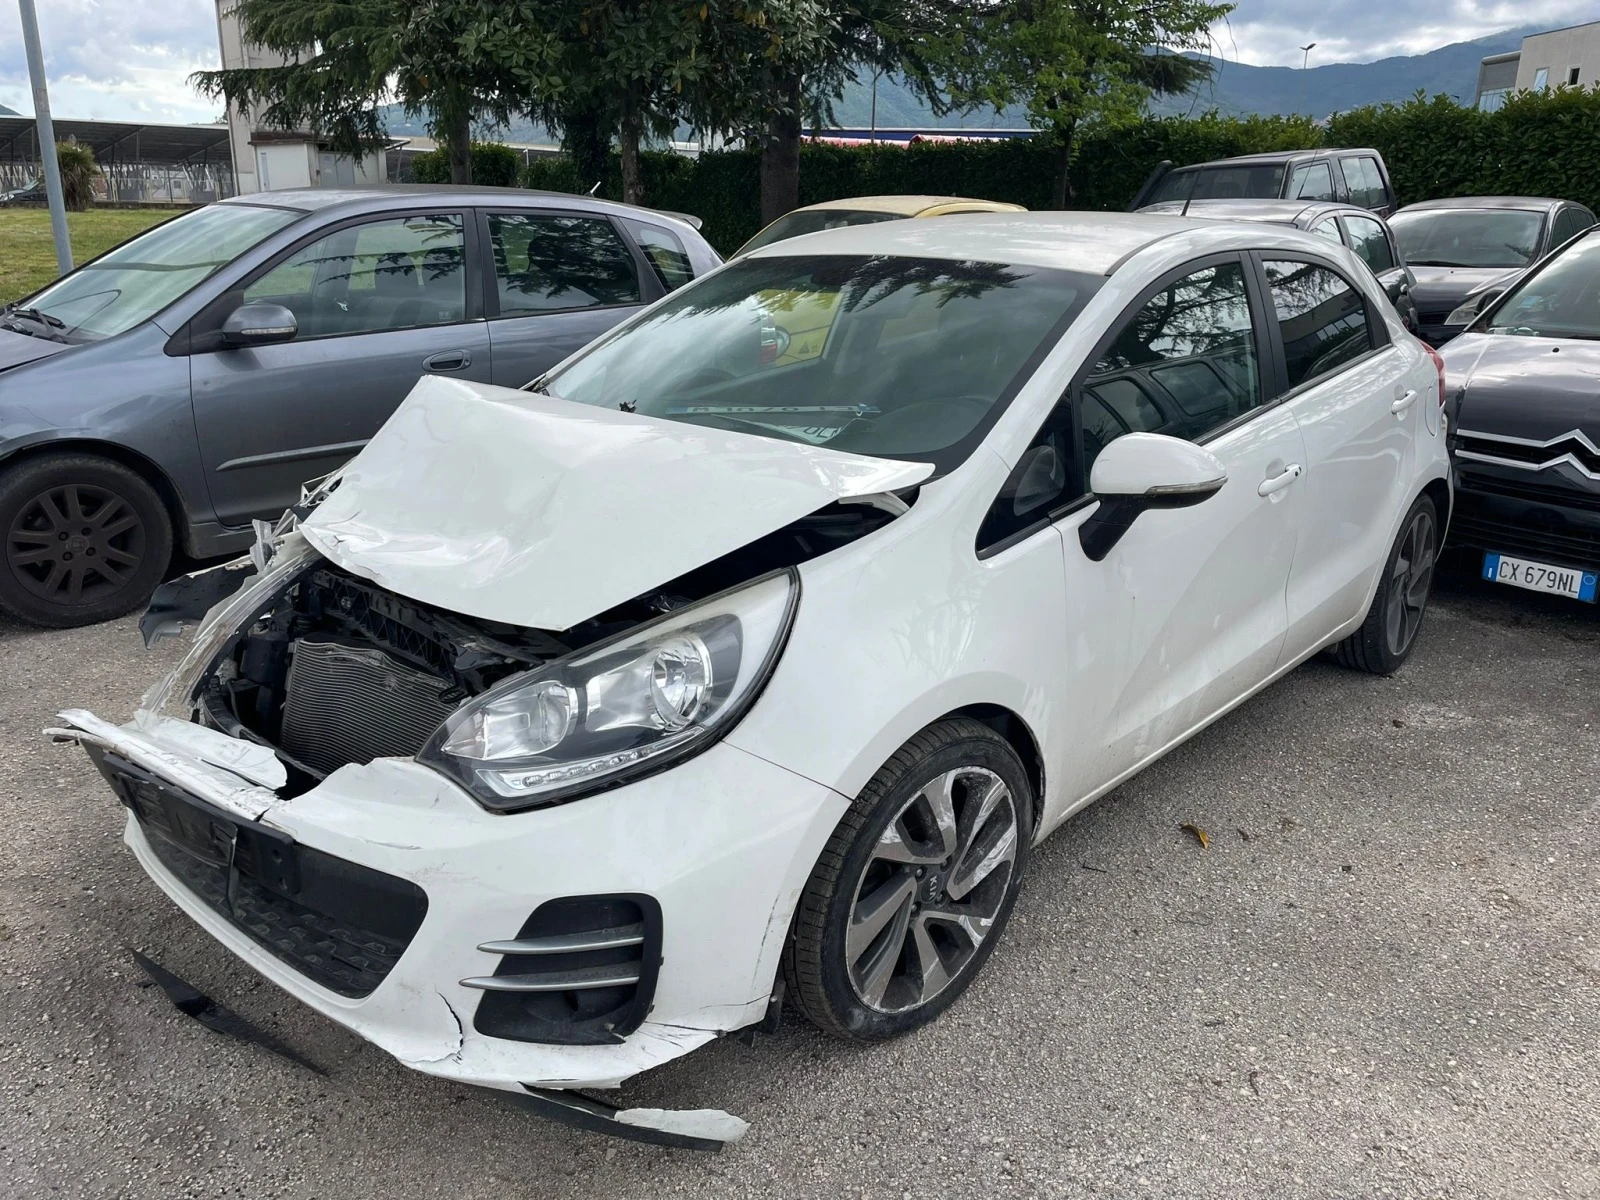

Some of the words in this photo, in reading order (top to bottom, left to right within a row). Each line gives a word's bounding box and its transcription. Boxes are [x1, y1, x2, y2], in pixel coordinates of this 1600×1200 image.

[1499, 561, 1520, 581] CX
[1524, 566, 1578, 593] 679NL
[929, 875, 938, 900] KIA
